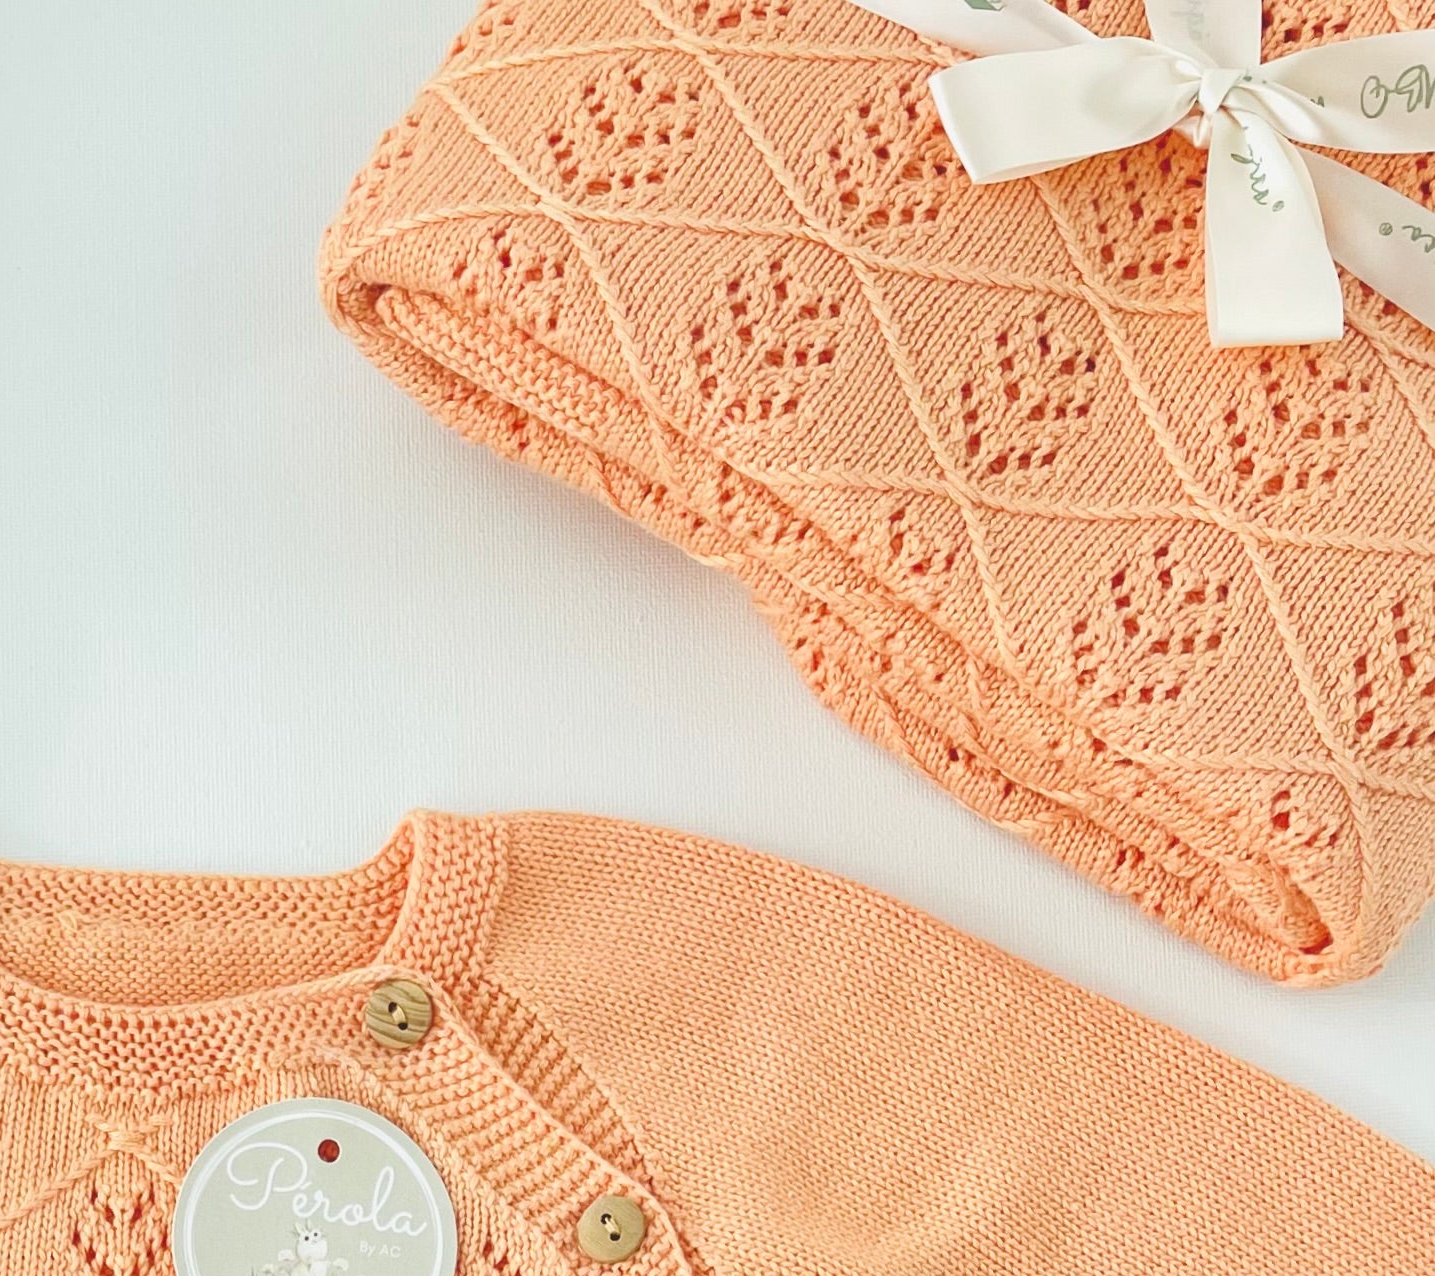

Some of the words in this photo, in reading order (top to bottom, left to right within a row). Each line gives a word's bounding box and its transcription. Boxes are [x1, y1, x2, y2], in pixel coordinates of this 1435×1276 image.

[226, 1141, 427, 1236] Pérola
[359, 1240, 376, 1257] By
[379, 1244, 401, 1258] AC
